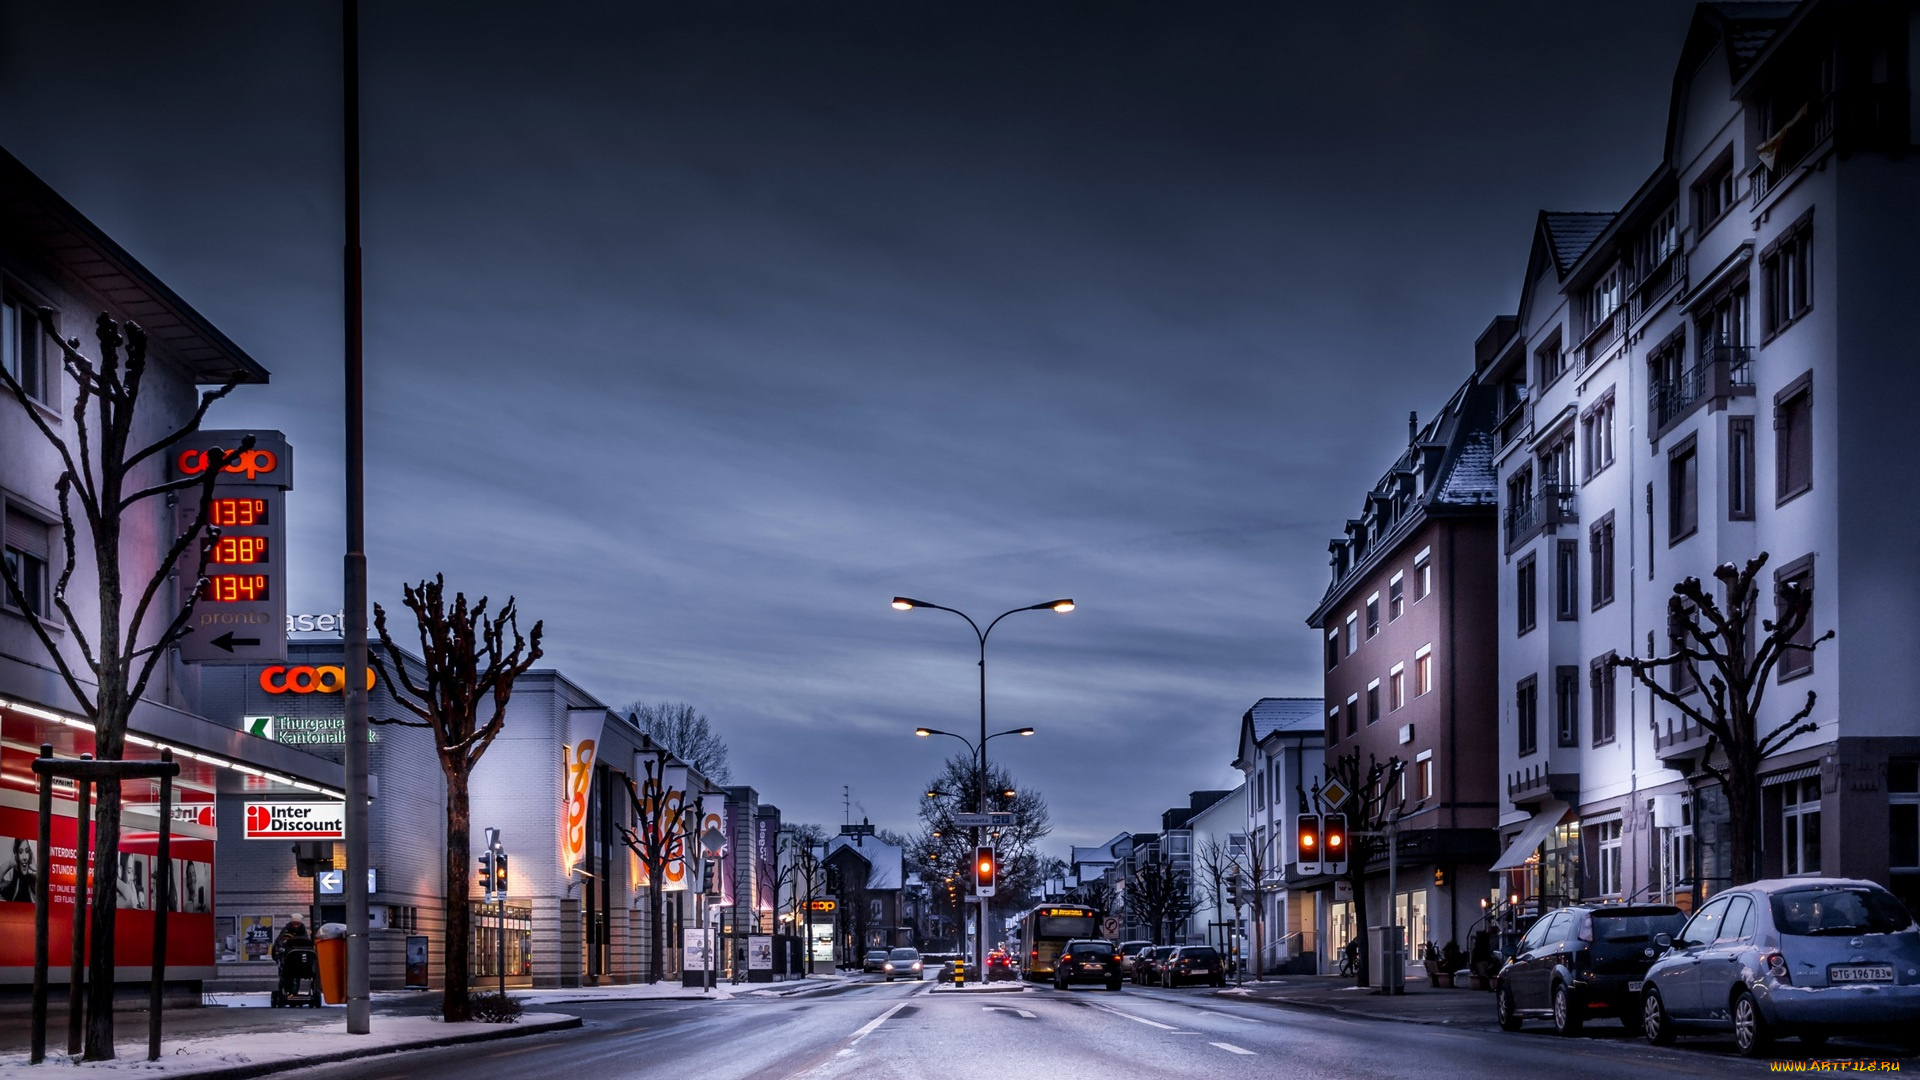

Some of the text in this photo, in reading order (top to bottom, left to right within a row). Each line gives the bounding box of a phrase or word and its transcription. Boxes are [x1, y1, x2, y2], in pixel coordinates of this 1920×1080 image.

[200, 610, 271, 627] pronto
[276, 716, 346, 733] Thurgaue
[278, 729, 377, 744] Kantonalk
[271, 806, 312, 818] Inter
[271, 818, 342, 831] Discount
